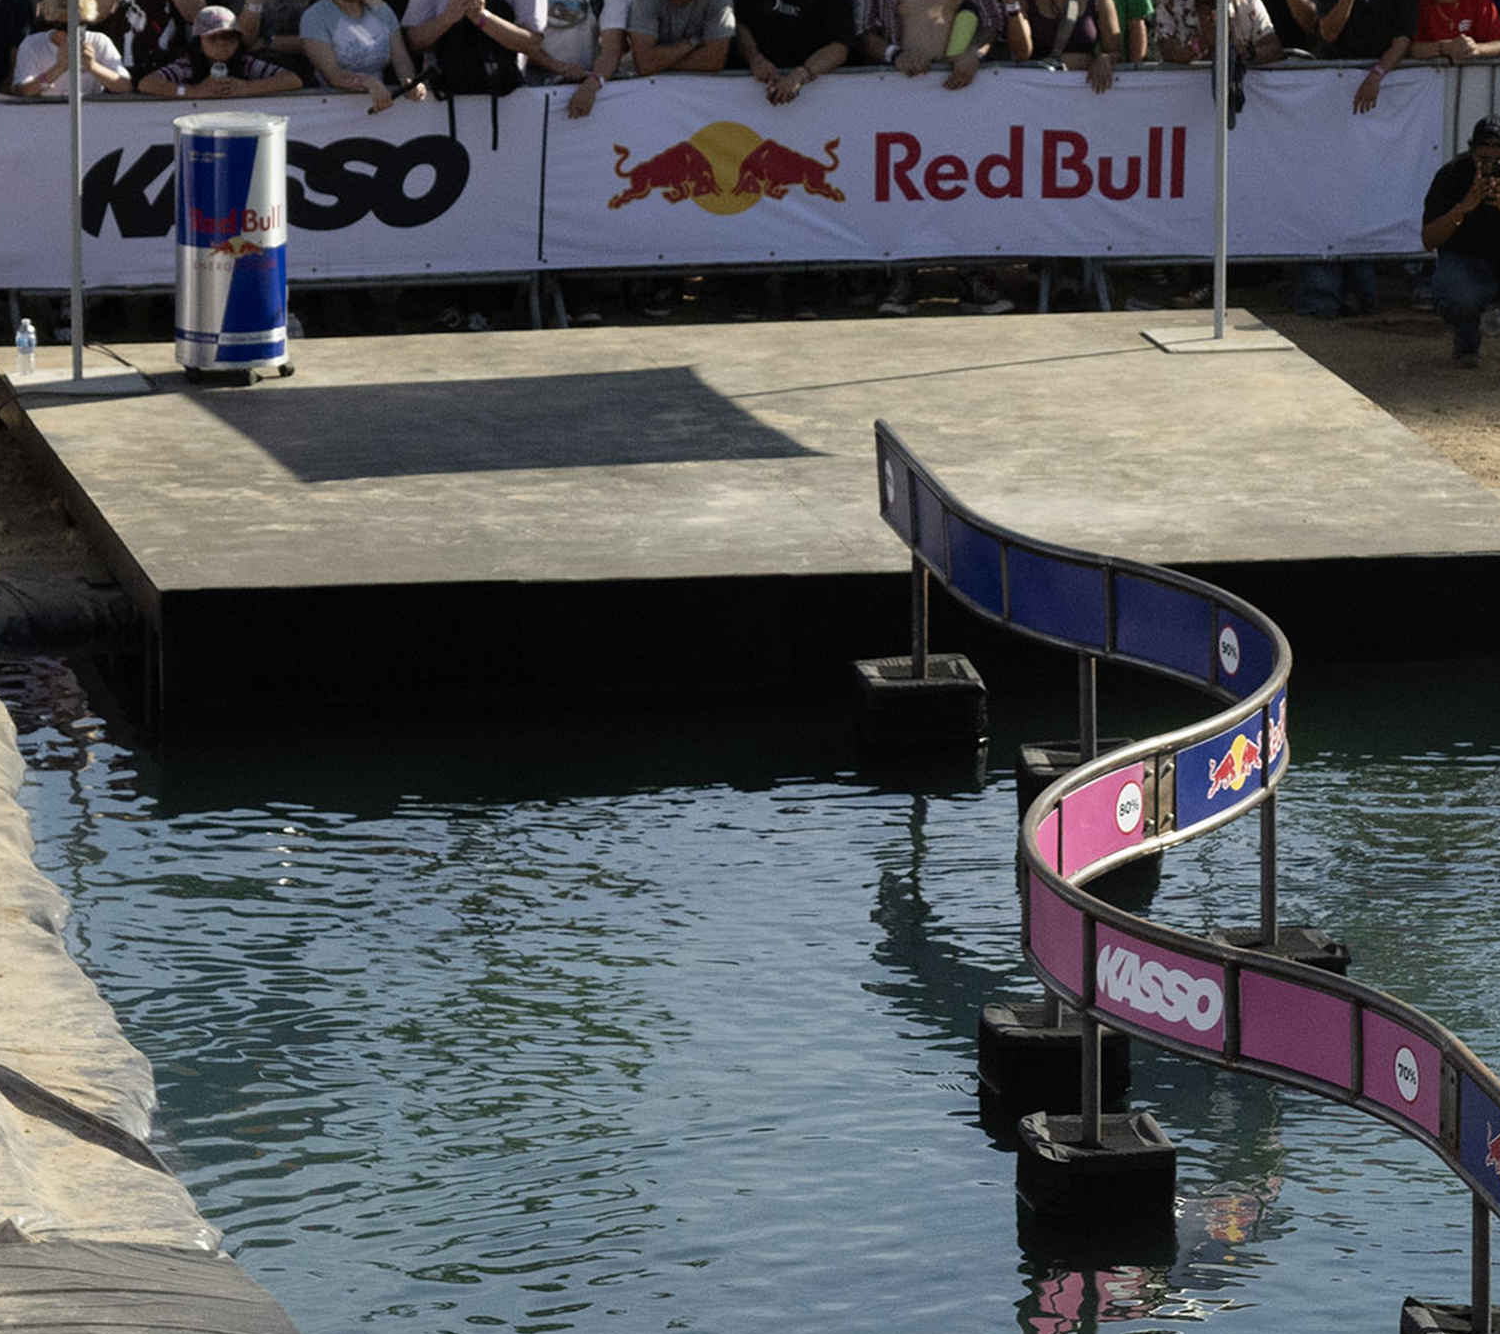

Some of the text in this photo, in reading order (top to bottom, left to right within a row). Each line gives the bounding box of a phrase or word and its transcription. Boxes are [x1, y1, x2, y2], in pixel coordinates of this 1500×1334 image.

[875, 124, 1186, 203] Red Bull
[190, 203, 282, 235] Red Bull
[1118, 797, 1140, 819] 80%
[1096, 942, 1225, 1032] KASSO
[1396, 1065, 1419, 1088] 70%
